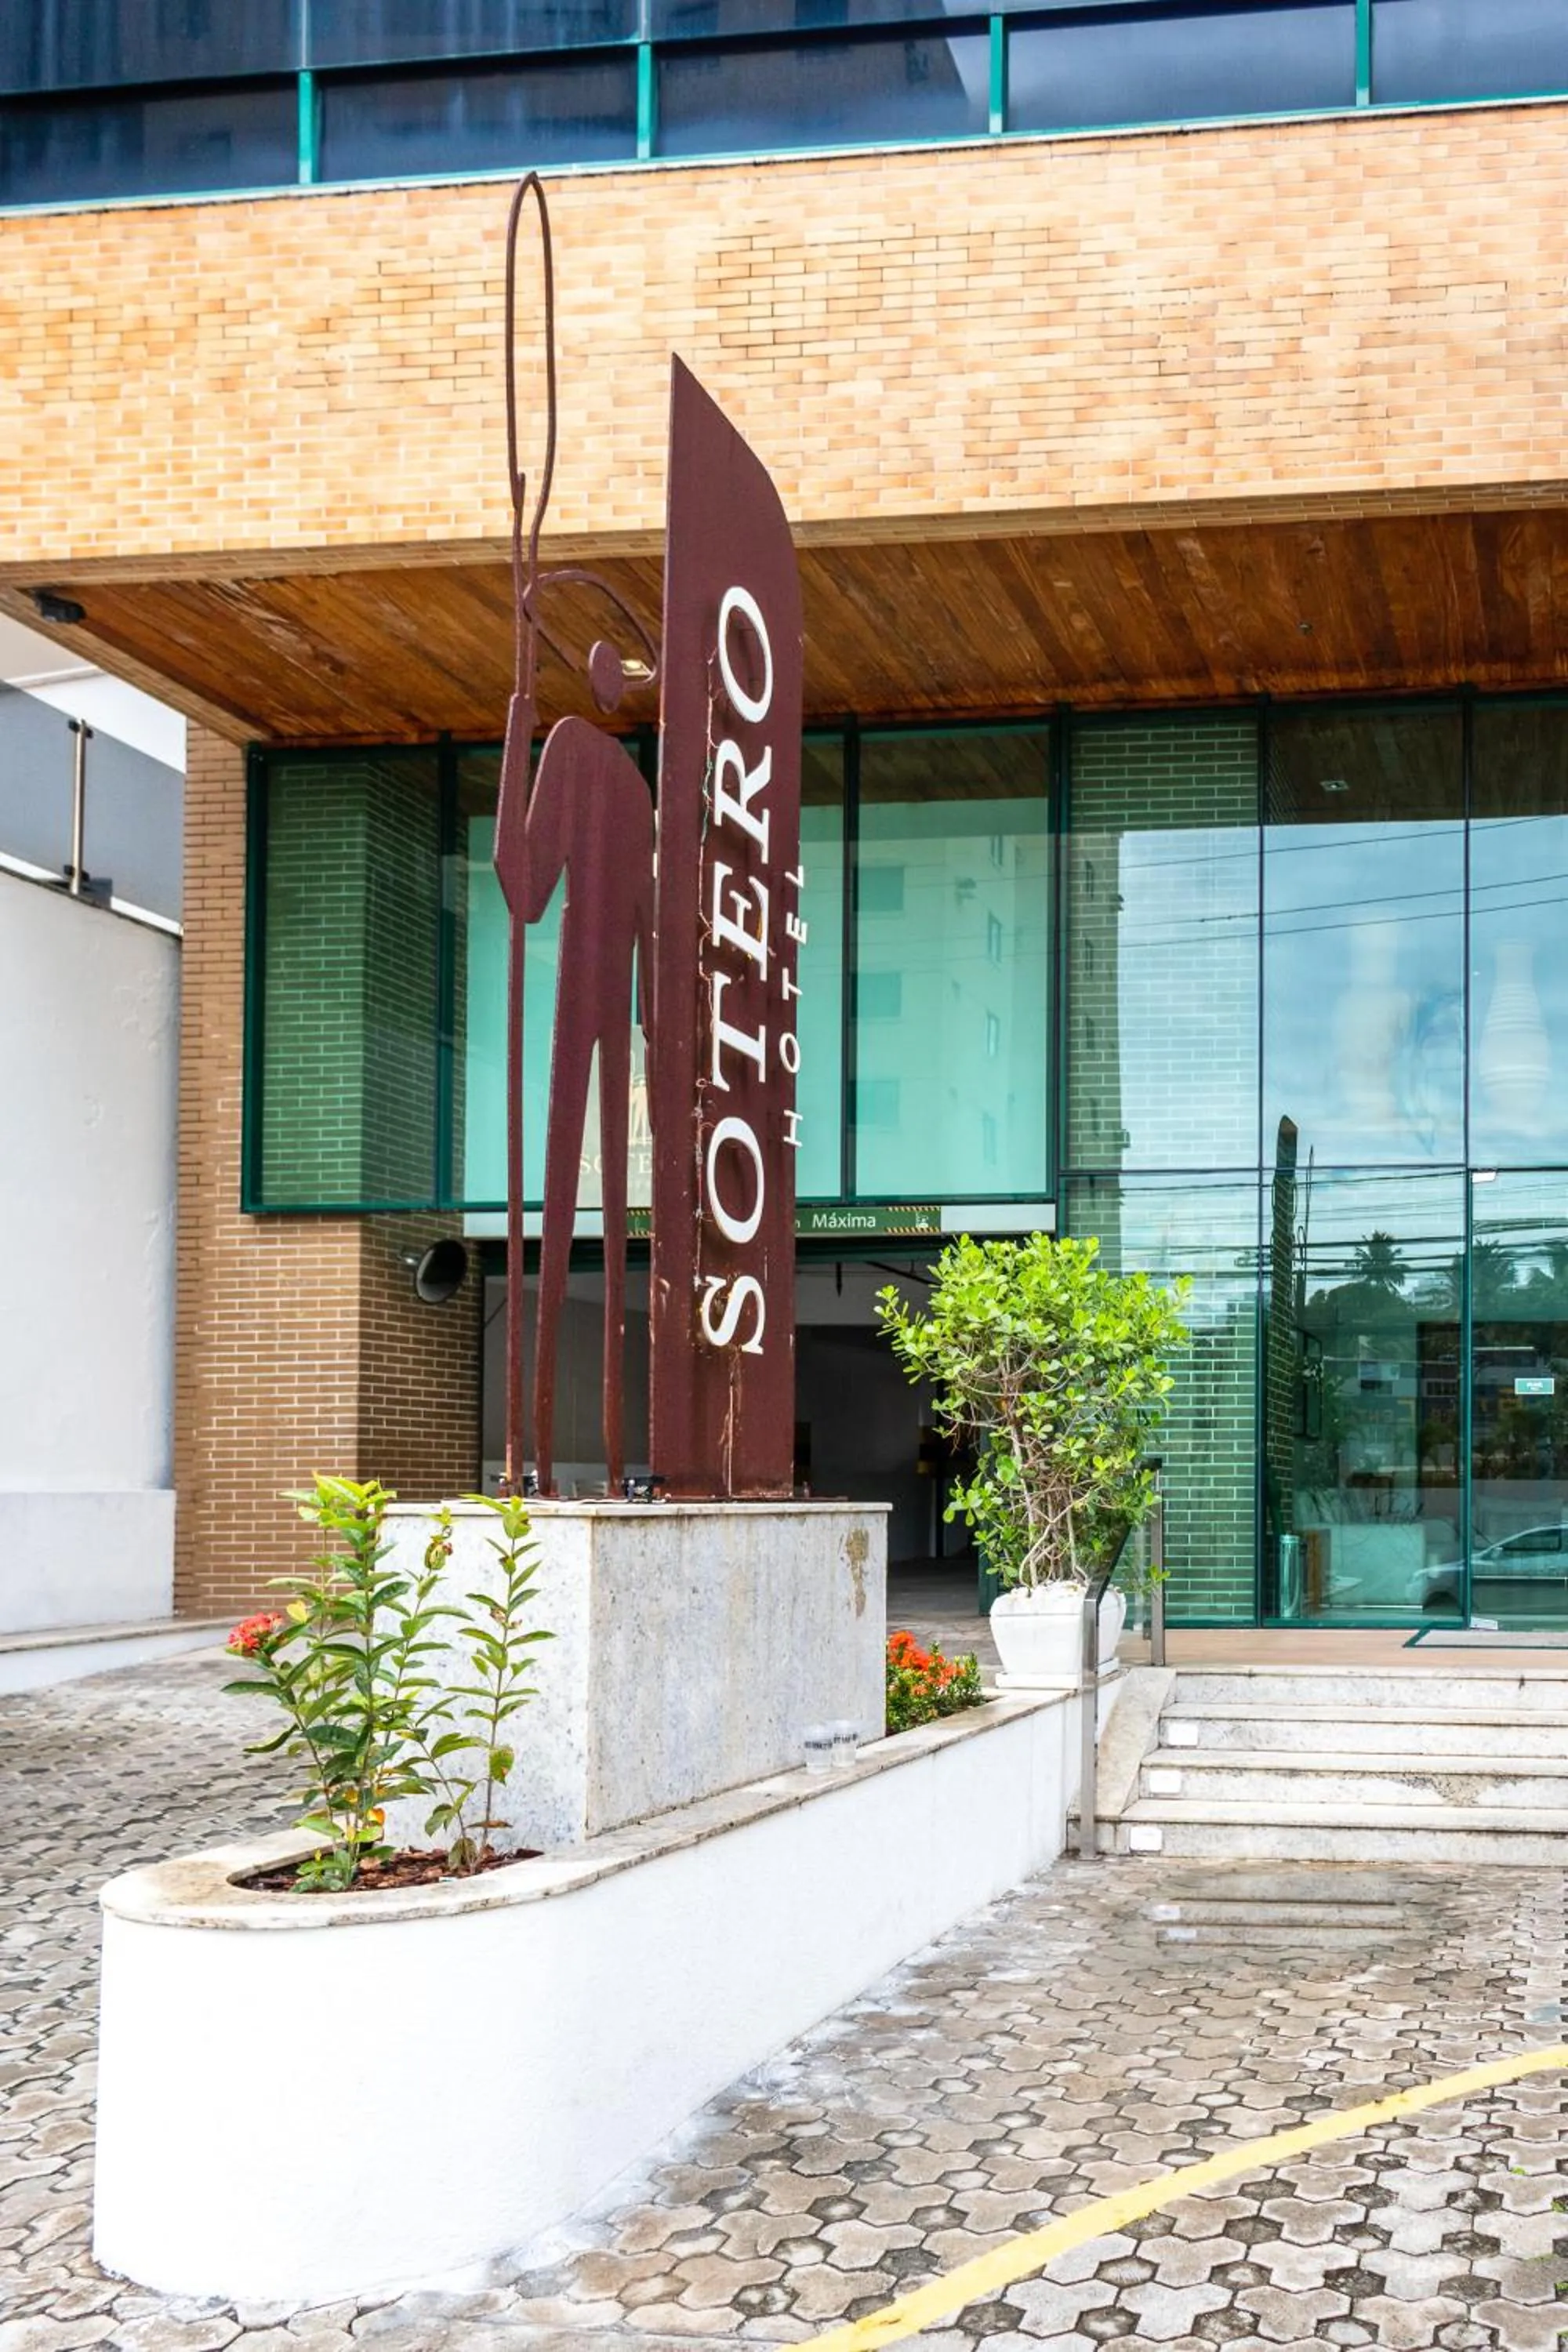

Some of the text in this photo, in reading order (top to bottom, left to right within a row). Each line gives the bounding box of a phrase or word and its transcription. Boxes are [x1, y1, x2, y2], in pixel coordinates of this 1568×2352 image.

[702, 586, 774, 1355] SOTERO
[779, 865, 808, 1147] HOTEL
[812, 1212, 877, 1229] Máxima
